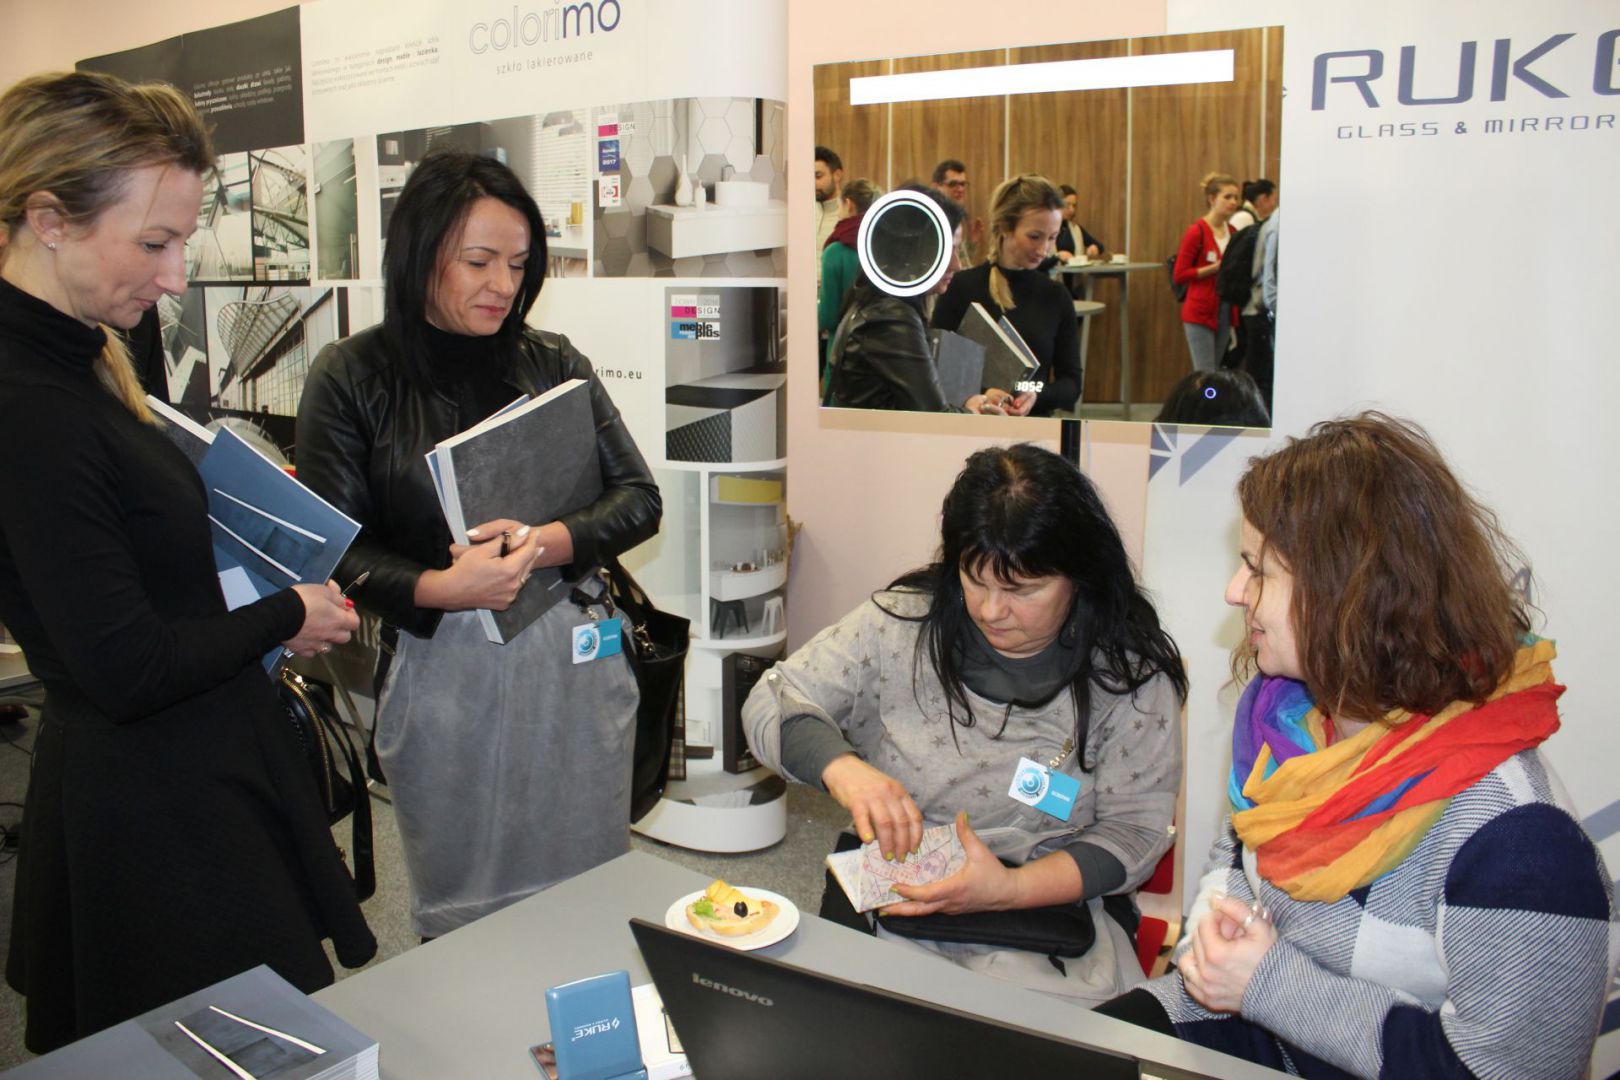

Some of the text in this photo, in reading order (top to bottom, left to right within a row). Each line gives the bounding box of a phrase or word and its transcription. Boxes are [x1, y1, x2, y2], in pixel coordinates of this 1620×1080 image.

[469, 0, 621, 54] colorimo
[526, 50, 593, 70] lakierowane
[1337, 122, 1439, 140] GLASS
[1454, 121, 1468, 135] &
[679, 322, 713, 332] meble
[595, 366, 642, 380] rimo.eu
[692, 972, 775, 1007] lenovo
[574, 1021, 611, 1039] RUKE
